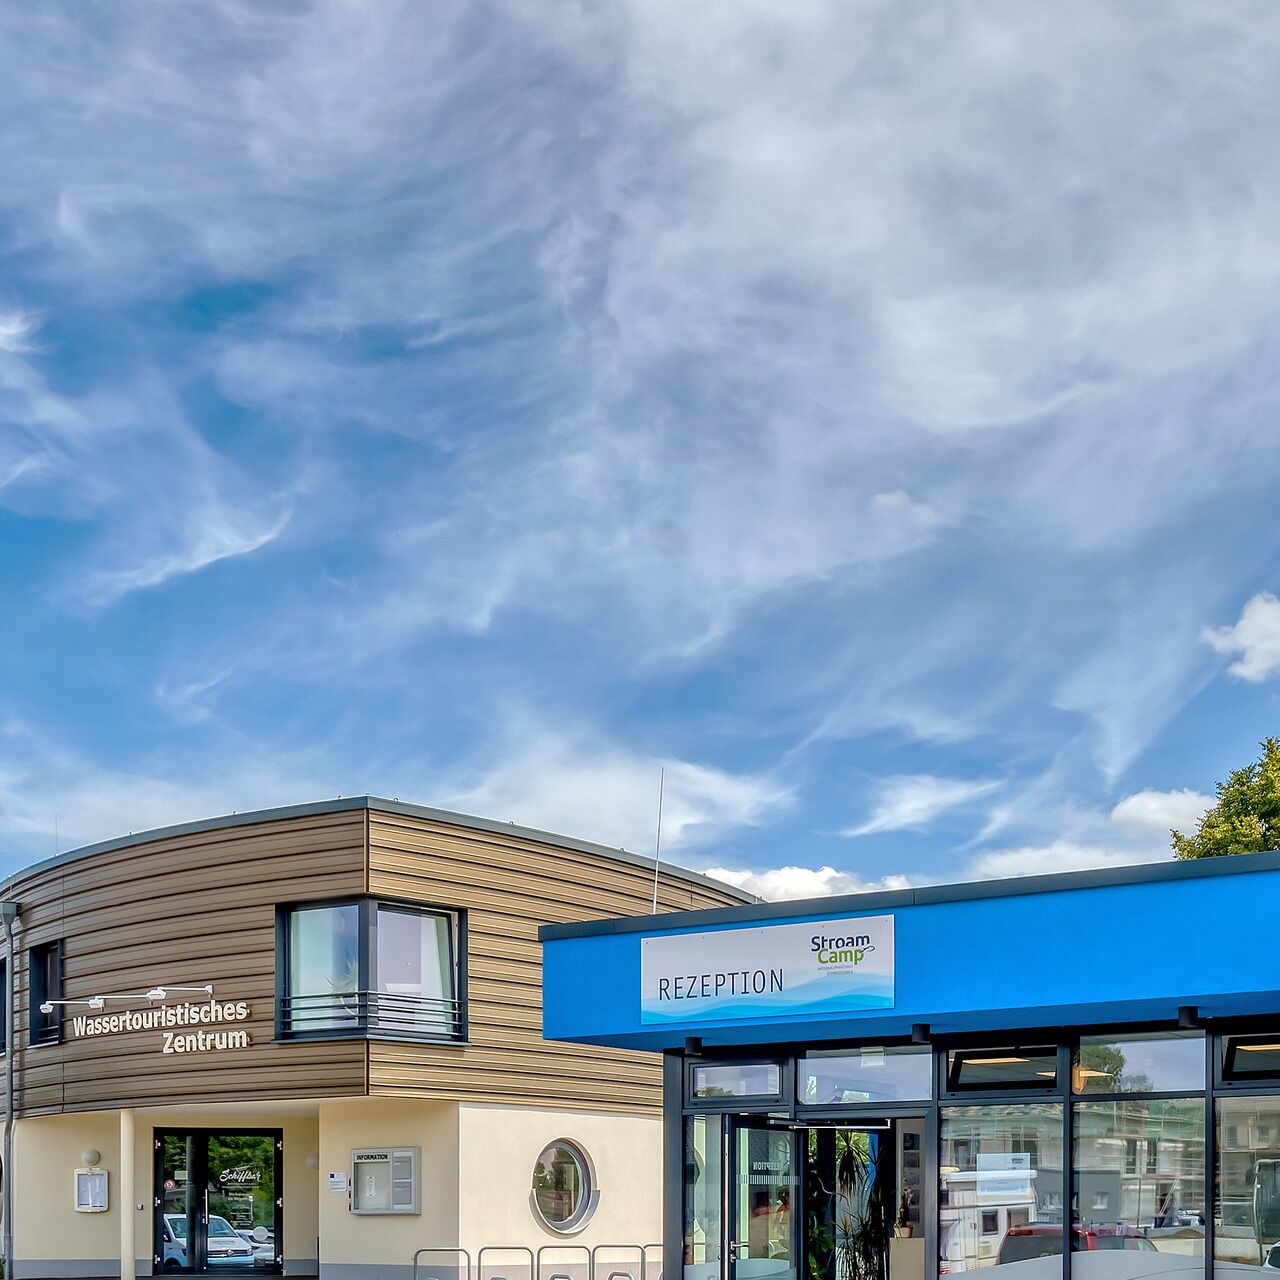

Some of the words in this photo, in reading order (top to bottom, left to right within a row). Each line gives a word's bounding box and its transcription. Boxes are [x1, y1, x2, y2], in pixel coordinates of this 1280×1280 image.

[811, 935, 870, 952] Stroam
[818, 948, 864, 966] Camp
[659, 969, 783, 1001] REZEPTION
[73, 1000, 247, 1037] Wassertouristisches
[163, 1030, 247, 1054] Zentrum
